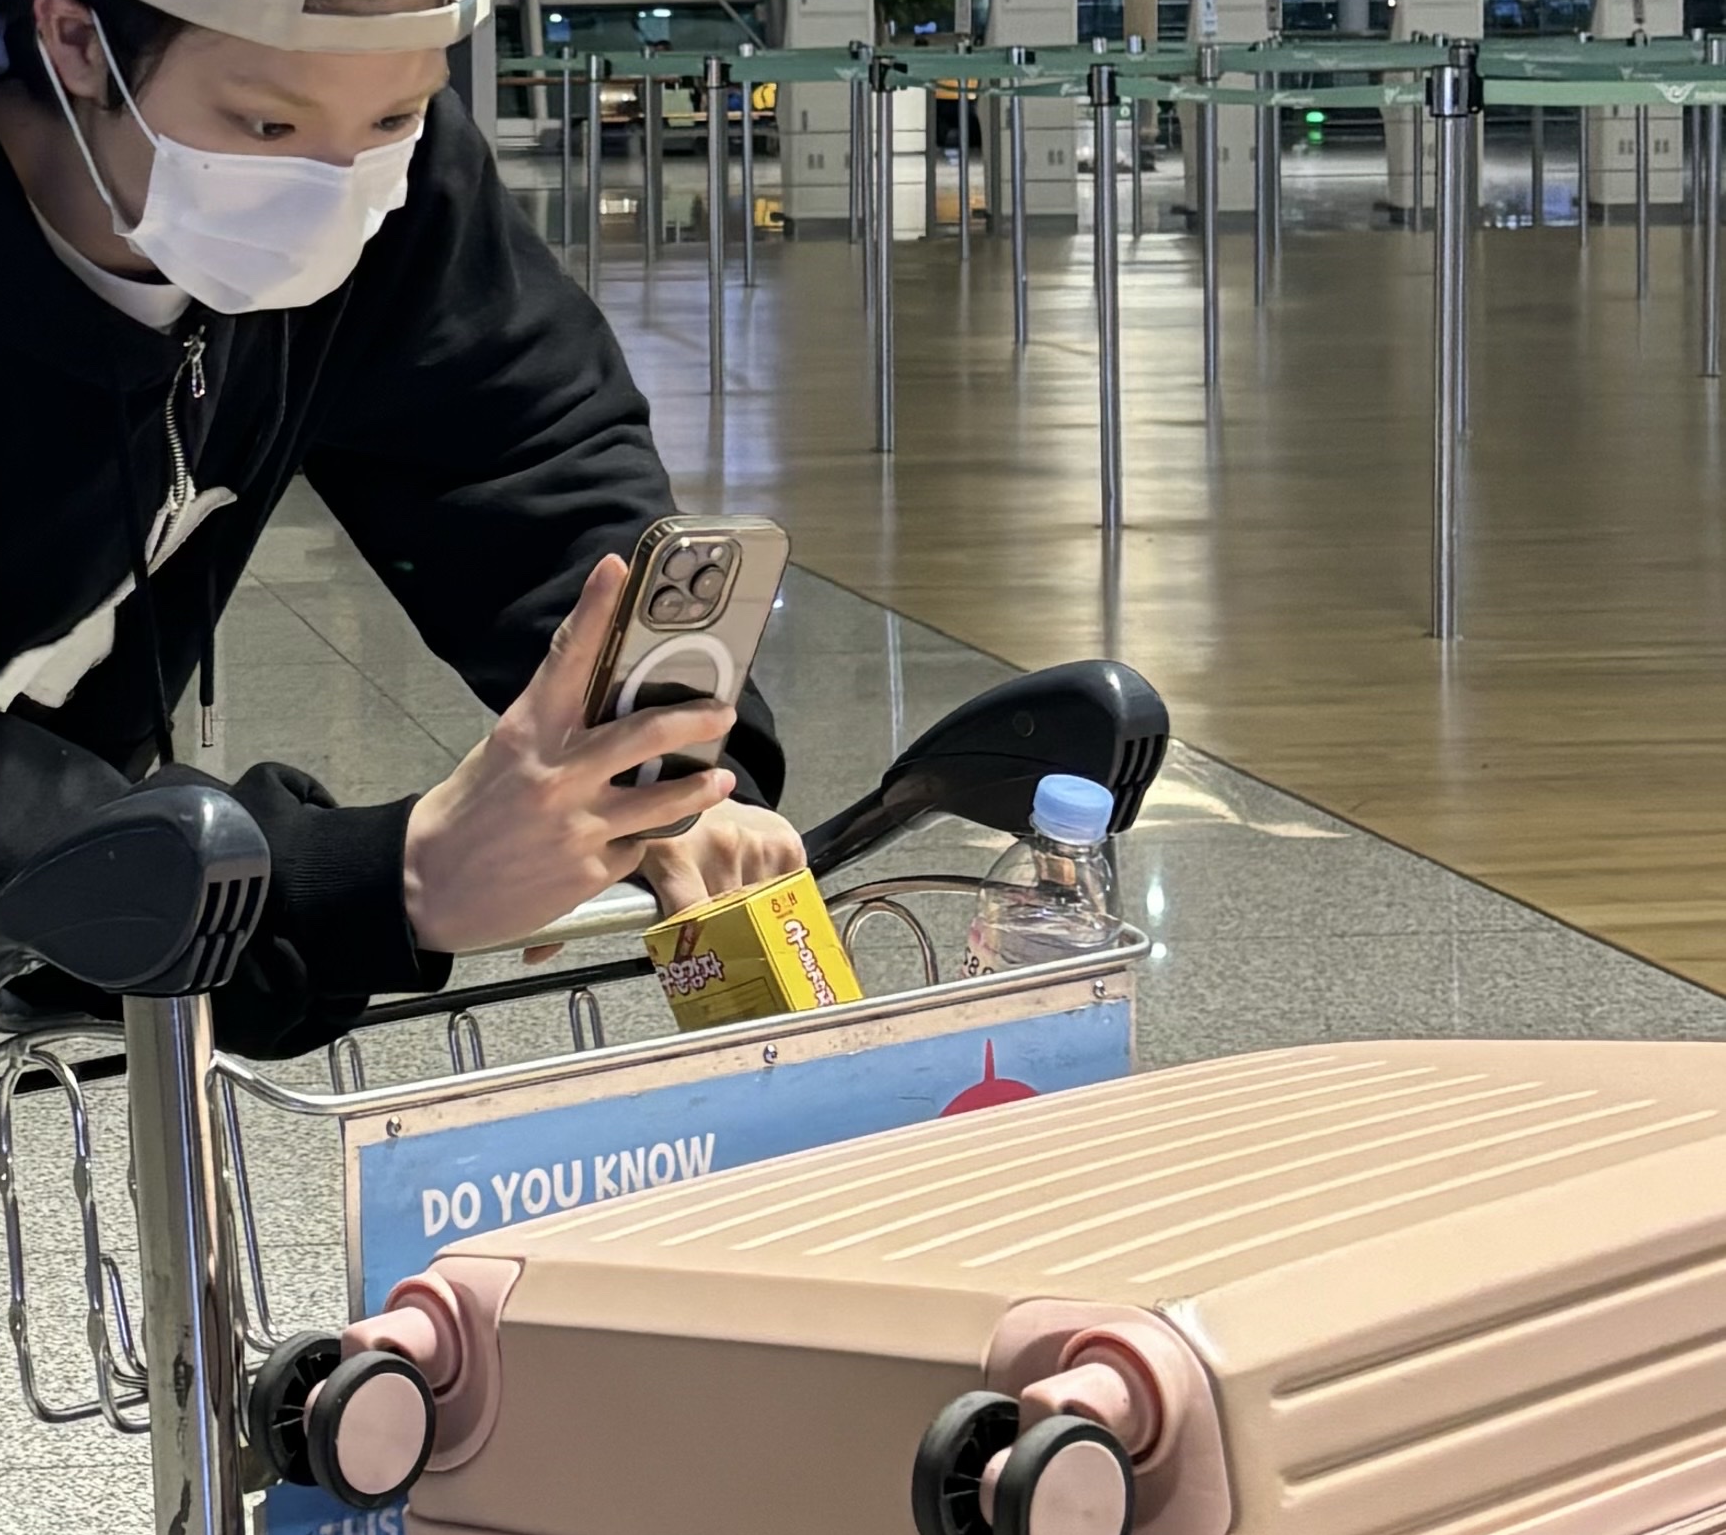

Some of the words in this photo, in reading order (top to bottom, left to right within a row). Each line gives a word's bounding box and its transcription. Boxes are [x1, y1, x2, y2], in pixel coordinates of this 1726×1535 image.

[422, 1181, 482, 1238] DO
[490, 1160, 584, 1224] YOU
[594, 1132, 716, 1201] KNOW
